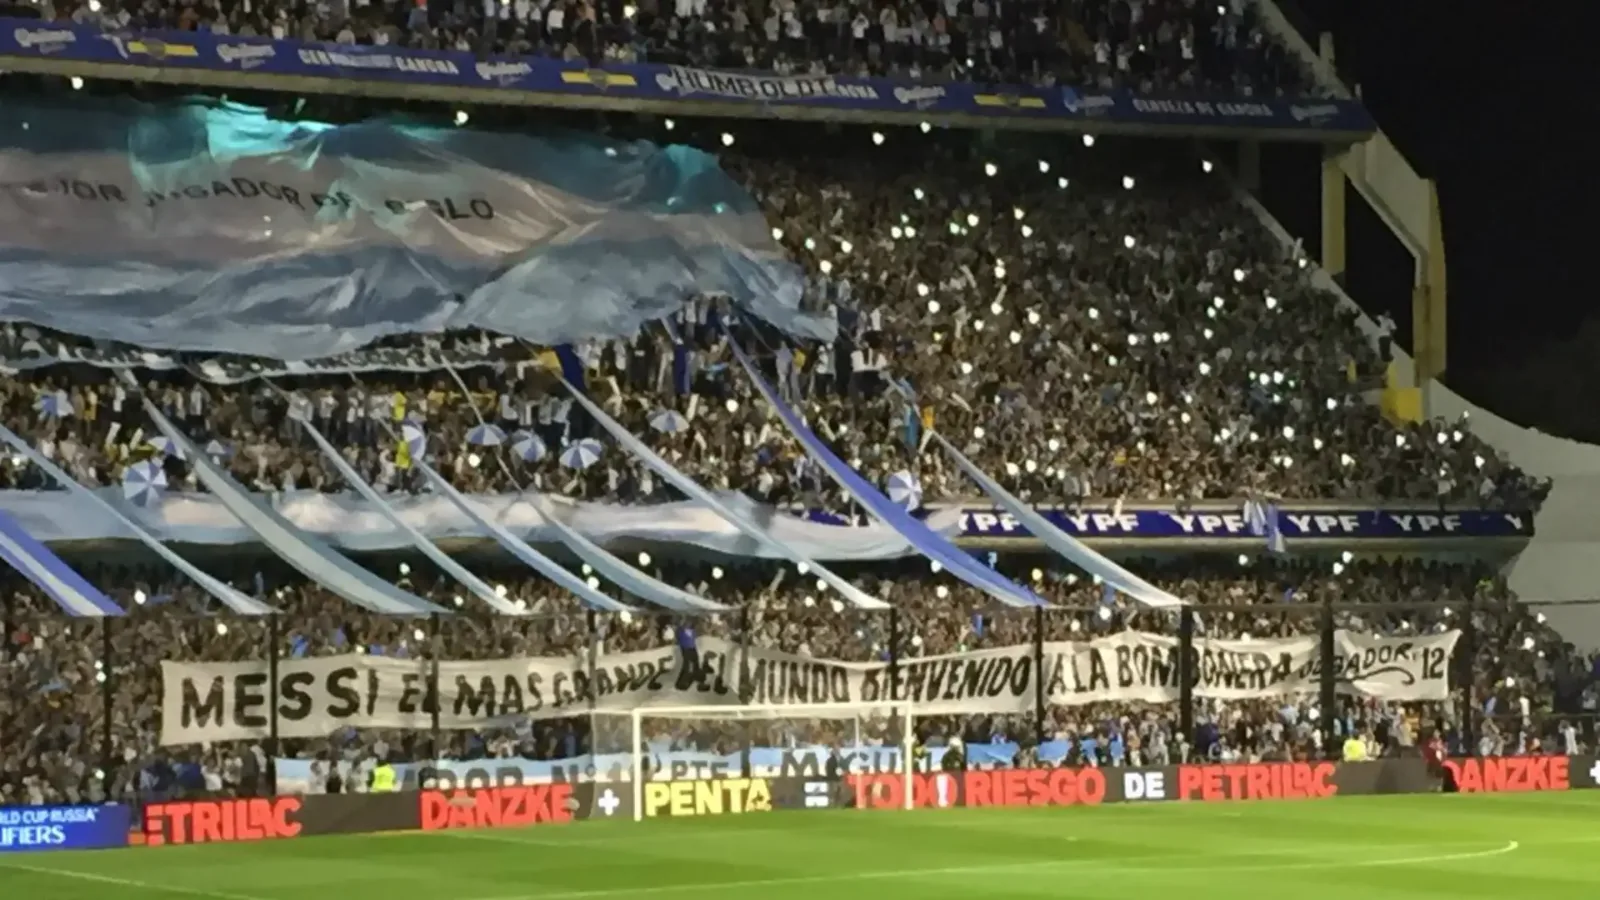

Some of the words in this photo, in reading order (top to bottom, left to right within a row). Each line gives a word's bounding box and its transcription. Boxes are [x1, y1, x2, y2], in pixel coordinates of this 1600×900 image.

[673, 67, 834, 99] HUMBOLDT
[1069, 513, 1139, 532] YPF
[1170, 514, 1246, 532] YPF
[1287, 515, 1360, 532] YPF
[1389, 515, 1462, 531] YPF
[181, 667, 379, 728] MESSI
[453, 671, 544, 717] MAS
[552, 655, 673, 708] GRANDE
[744, 658, 850, 704] MUNDO
[860, 655, 1031, 703] BIENVENIDO
[1421, 647, 1445, 680] 12
[420, 781, 574, 830] DANZKE
[645, 778, 772, 816] PENTA
[965, 768, 1106, 807] RIESGO
[1124, 771, 1165, 799] DE
[1179, 762, 1338, 802] PETRILAC
